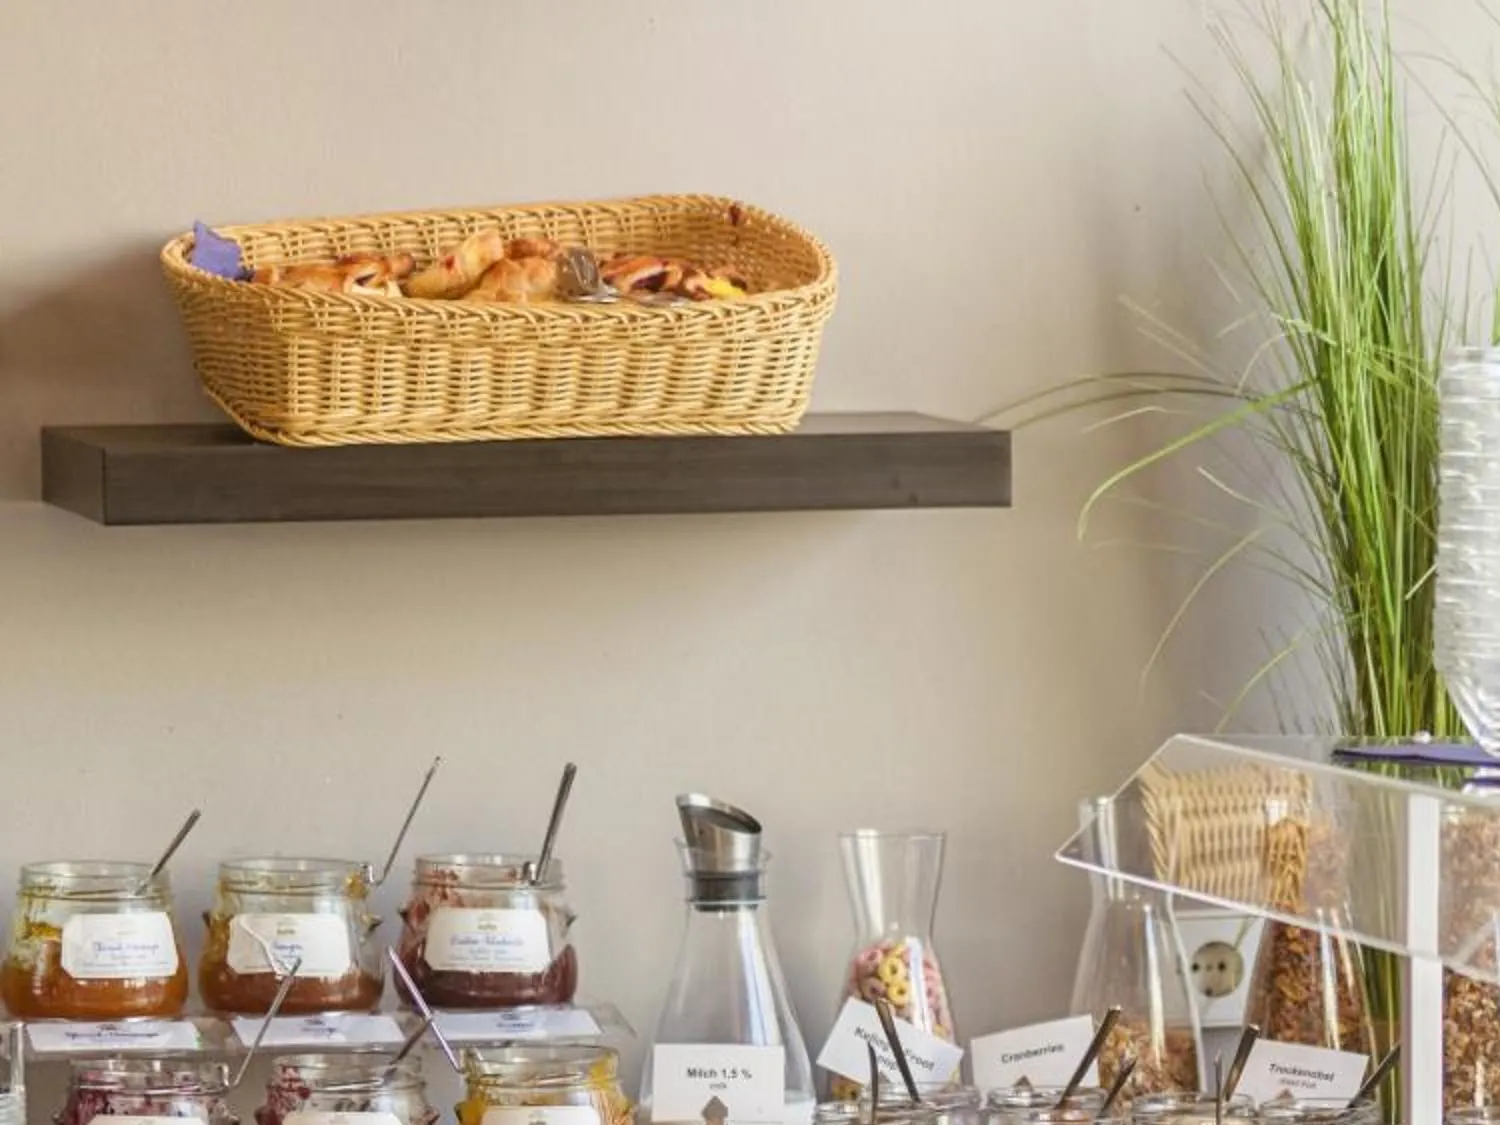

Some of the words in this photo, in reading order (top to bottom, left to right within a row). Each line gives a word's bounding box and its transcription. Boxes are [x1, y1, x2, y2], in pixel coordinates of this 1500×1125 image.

[1001, 1043, 1065, 1063] Cranberries
[687, 1067, 718, 1079] Milch
[721, 1067, 738, 1081] 1,5
[740, 1067, 753, 1080] %
